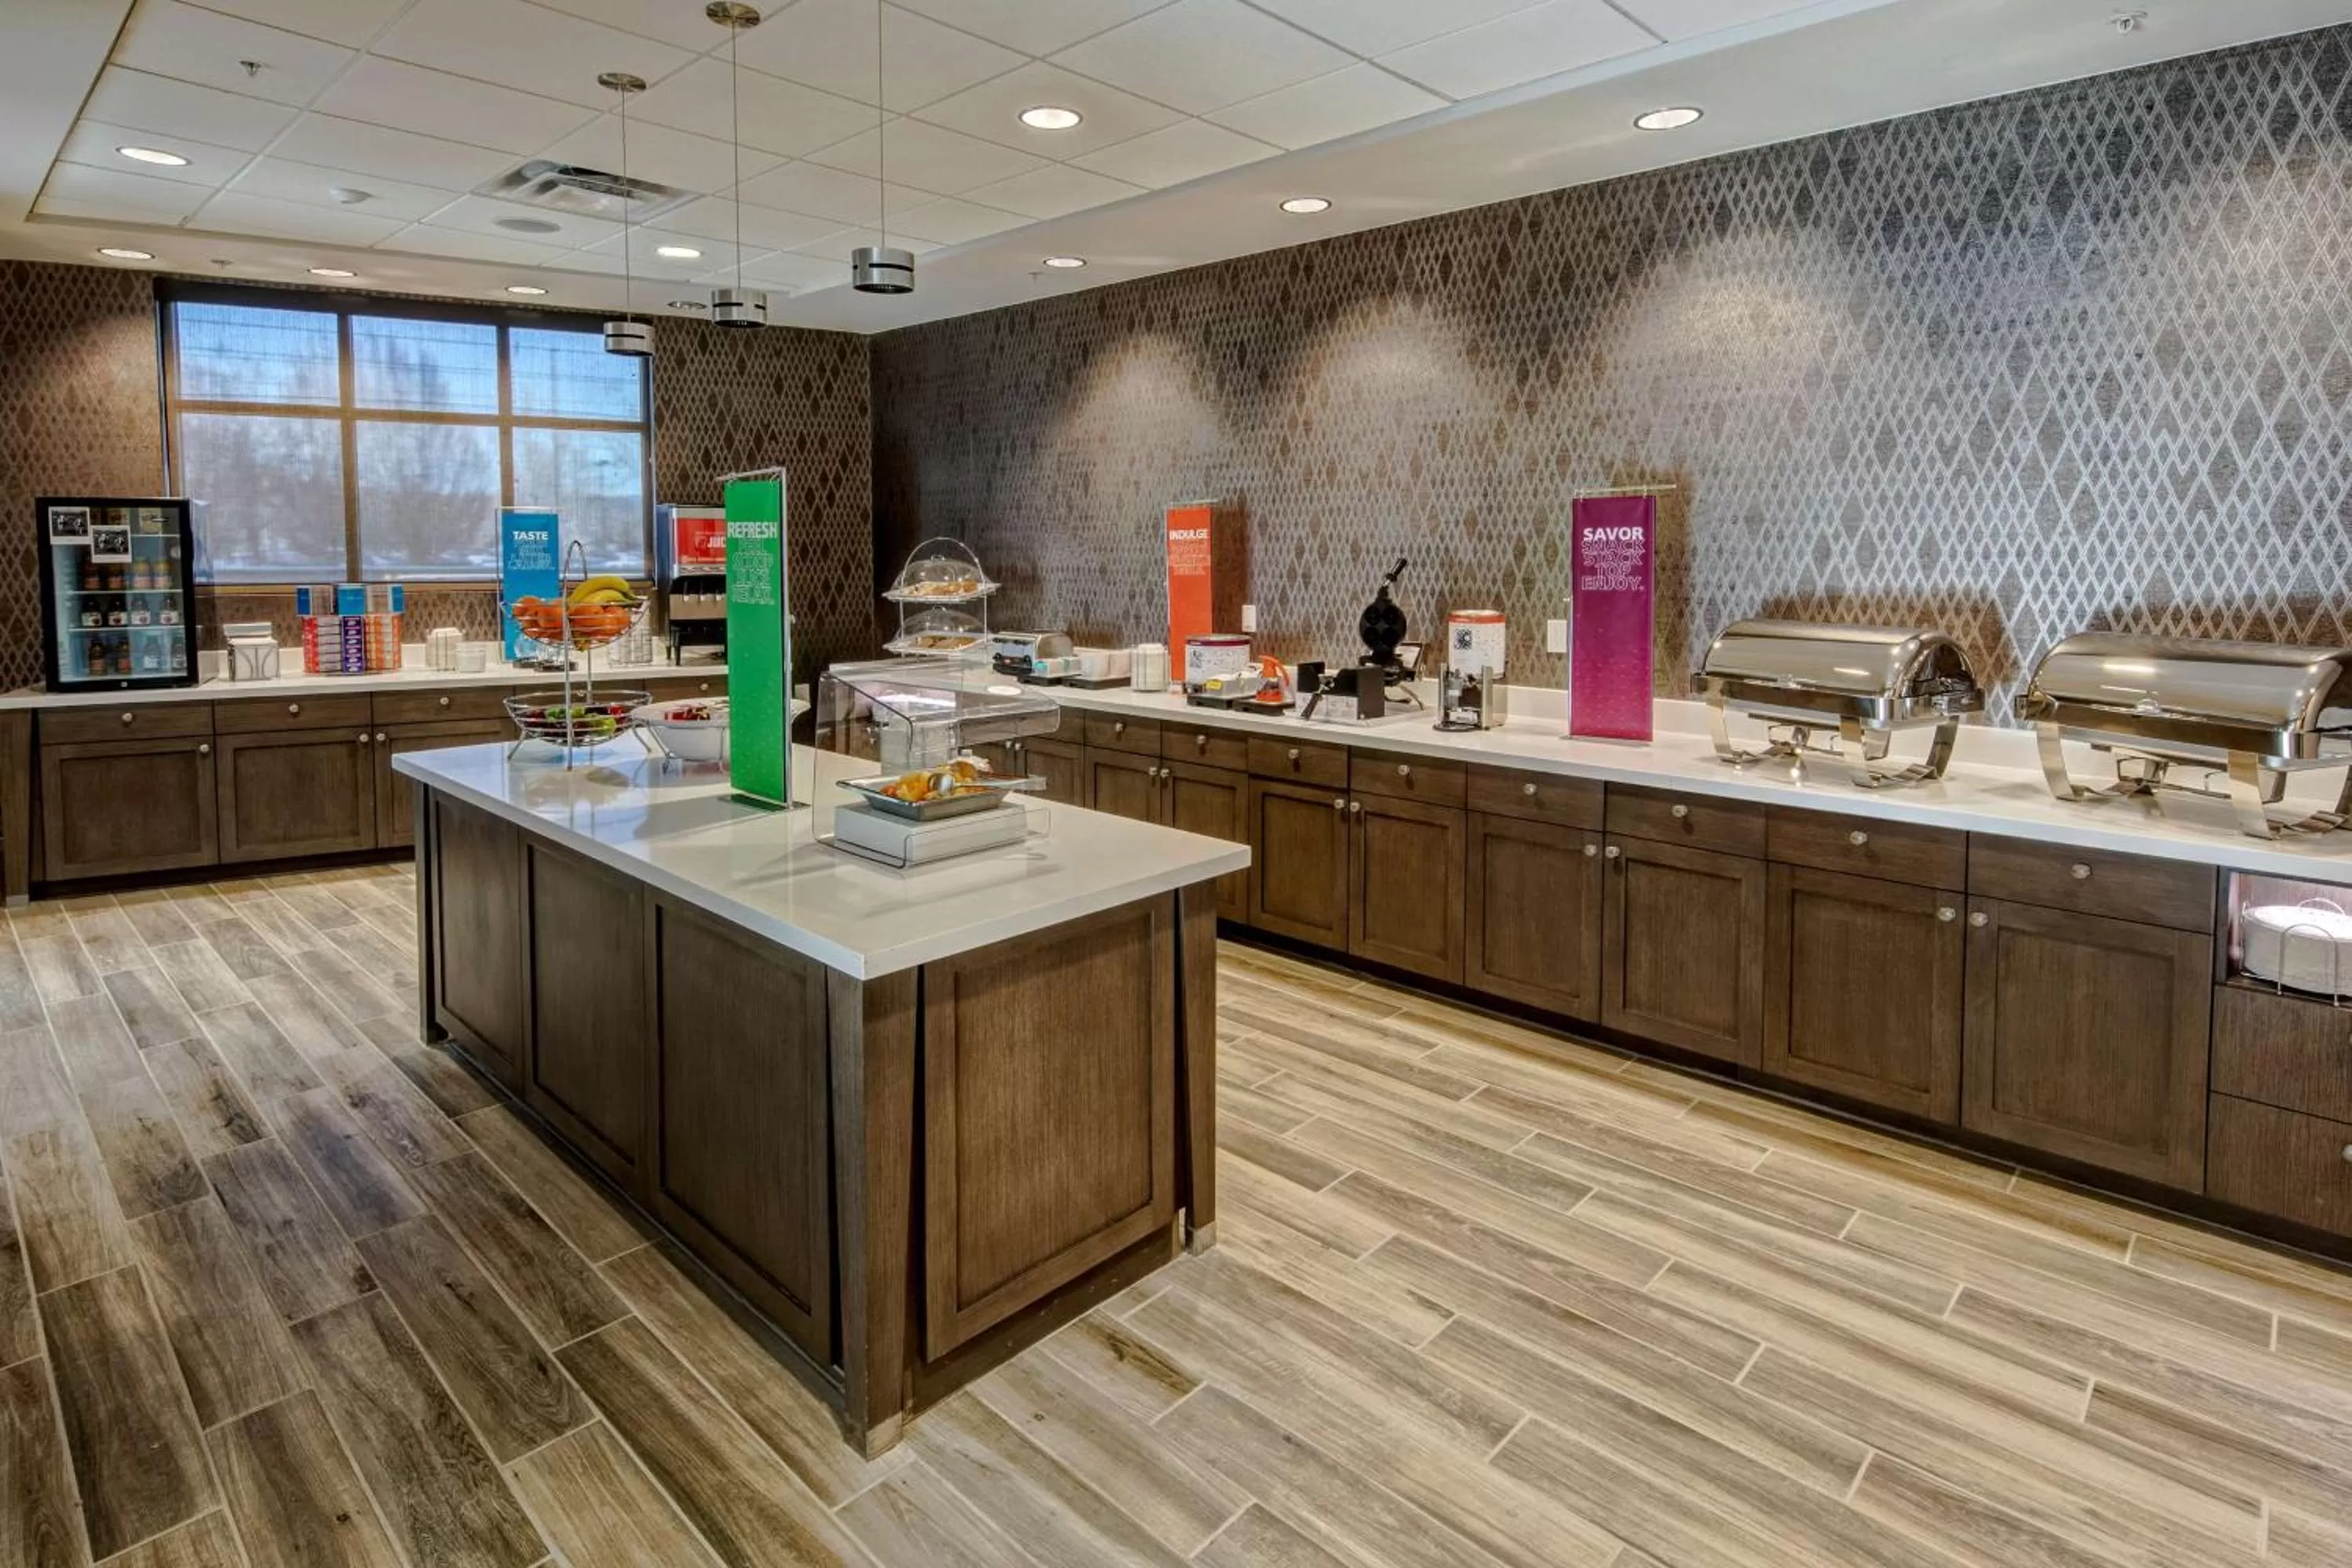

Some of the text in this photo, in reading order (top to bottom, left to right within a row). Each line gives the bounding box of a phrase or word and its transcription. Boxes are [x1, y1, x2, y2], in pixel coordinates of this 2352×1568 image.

[512, 531, 549, 540] TASTE
[727, 521, 778, 539] REFRESH
[1583, 526, 1644, 541] SAVOR
[706, 535, 726, 548] JUIC
[1581, 576, 1645, 591] ENJOY.
